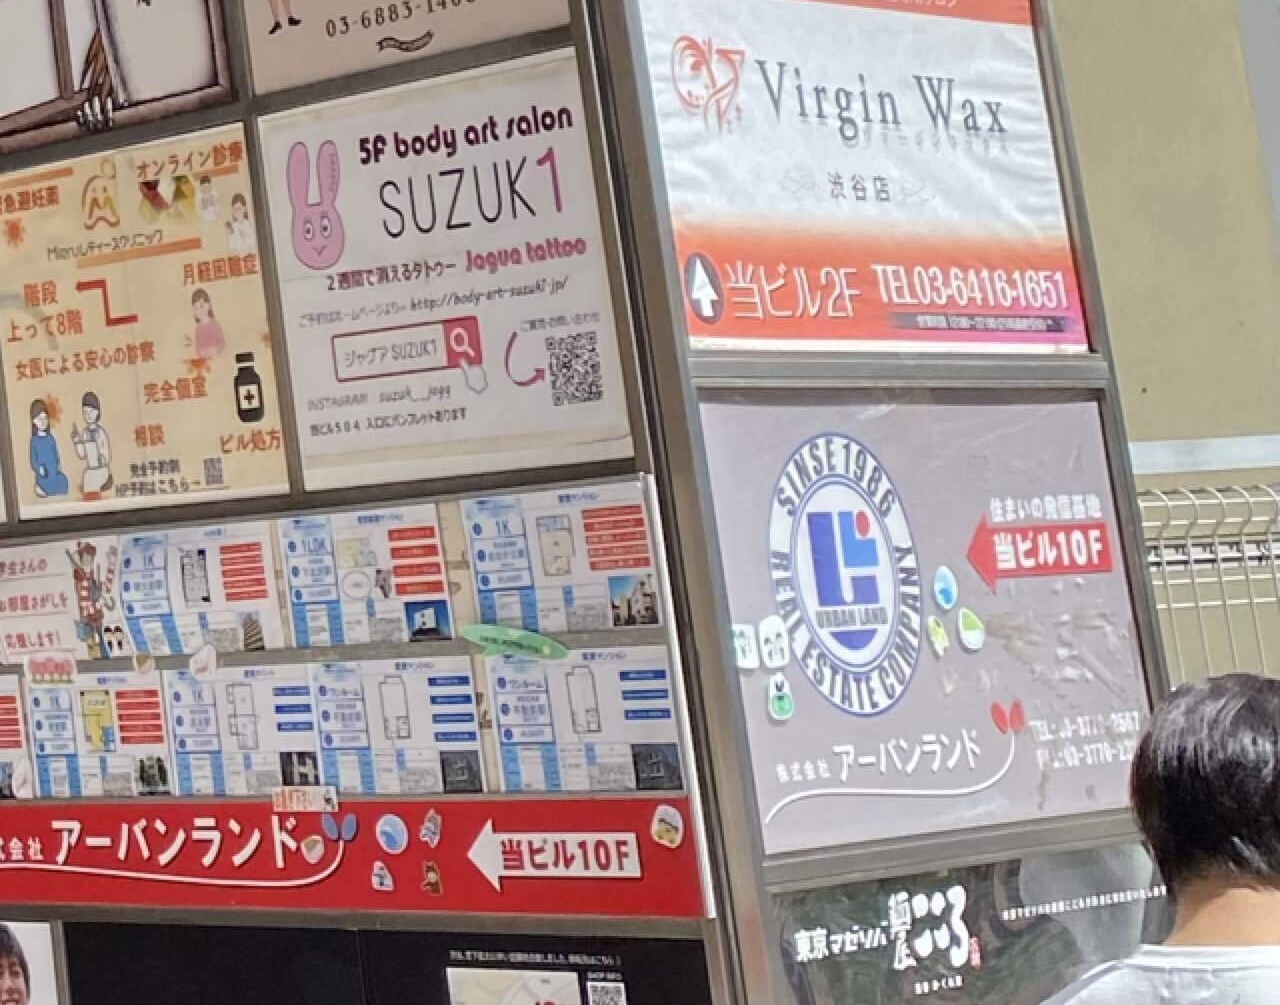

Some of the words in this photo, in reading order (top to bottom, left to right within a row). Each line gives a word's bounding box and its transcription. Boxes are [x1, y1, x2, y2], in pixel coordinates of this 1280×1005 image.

[755, 59, 902, 141] Virgin
[912, 74, 1008, 134] Wax
[394, 123, 458, 163] body
[463, 114, 500, 147] art
[505, 103, 574, 139] salon
[827, 172, 892, 203] 渋谷店
[525, 234, 588, 264] tattoo
[24, 280, 59, 308] 階段
[726, 259, 864, 319] 当ビル2F
[6, 310, 84, 343] 上って8階
[143, 376, 209, 404] 完全個室
[841, 442, 895, 518] 1986
[994, 531, 1105, 571] 当ビル10F
[833, 729, 982, 782] アーバンランド
[51, 814, 300, 870] アーバンランド
[500, 836, 634, 873] 当ビル10F
